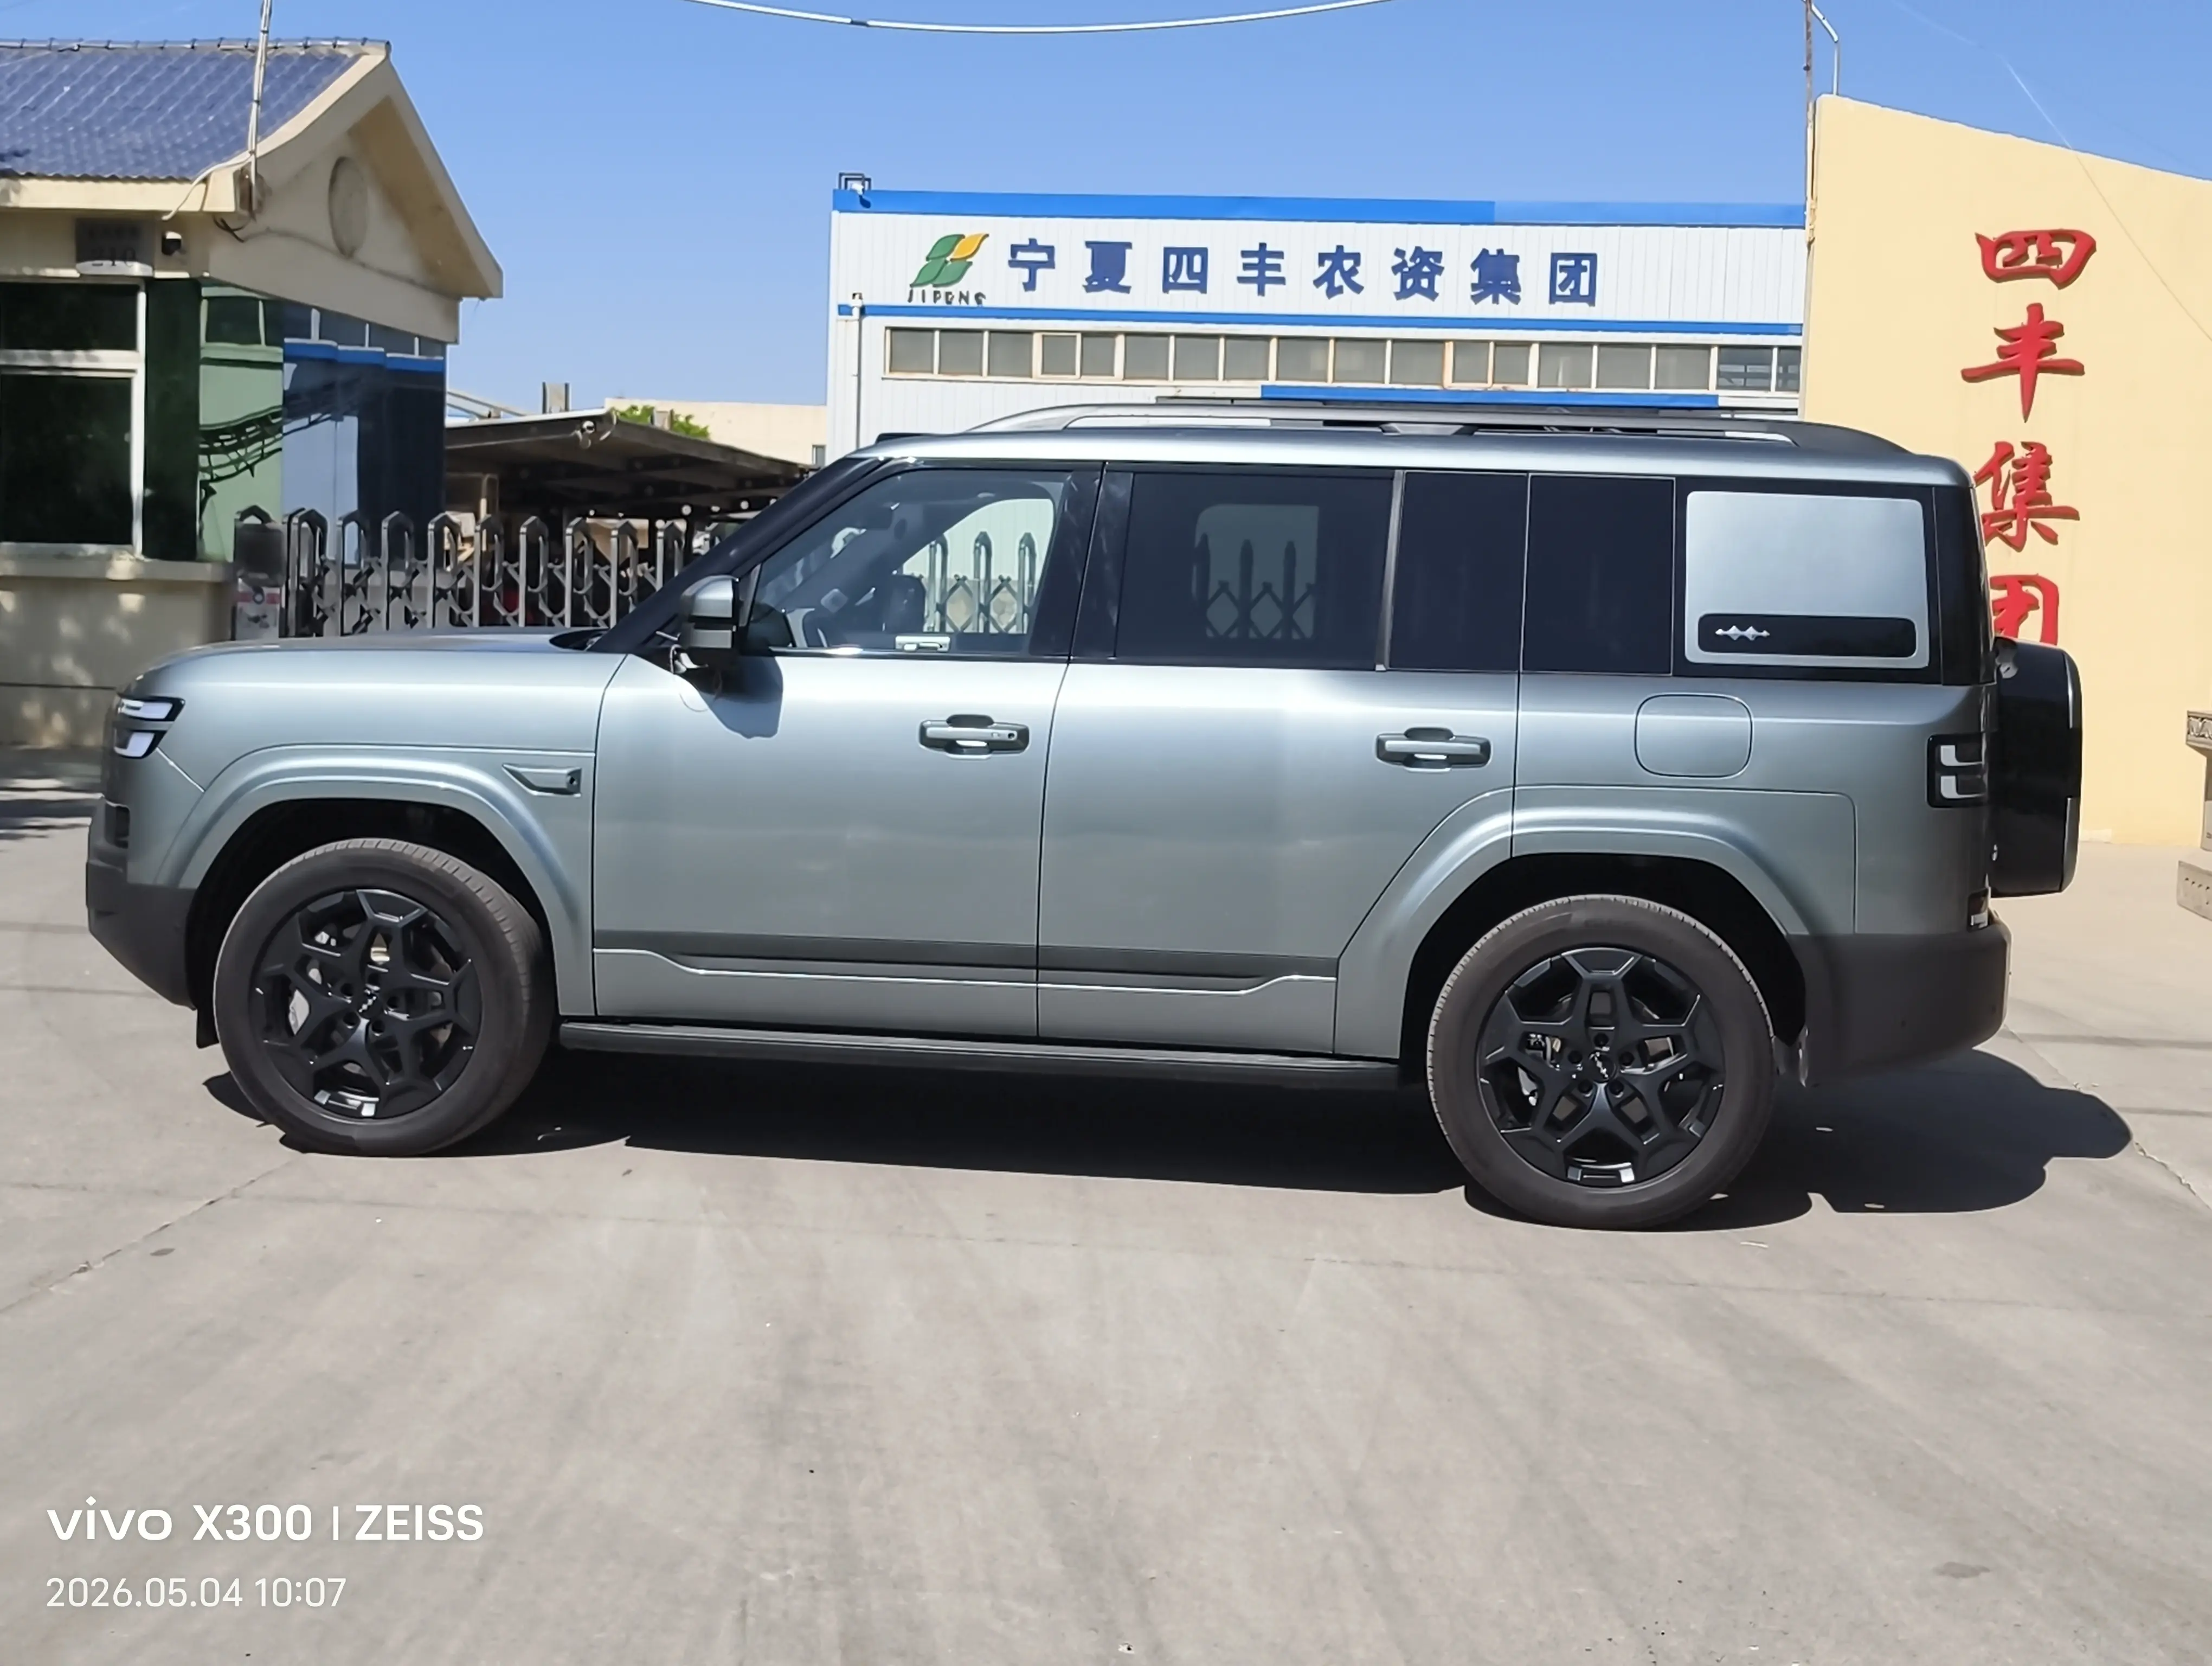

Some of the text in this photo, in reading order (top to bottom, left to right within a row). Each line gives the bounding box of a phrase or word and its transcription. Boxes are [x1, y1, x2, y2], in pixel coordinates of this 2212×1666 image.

[1008, 238, 1598, 305] 宁夏四丰农资集团
